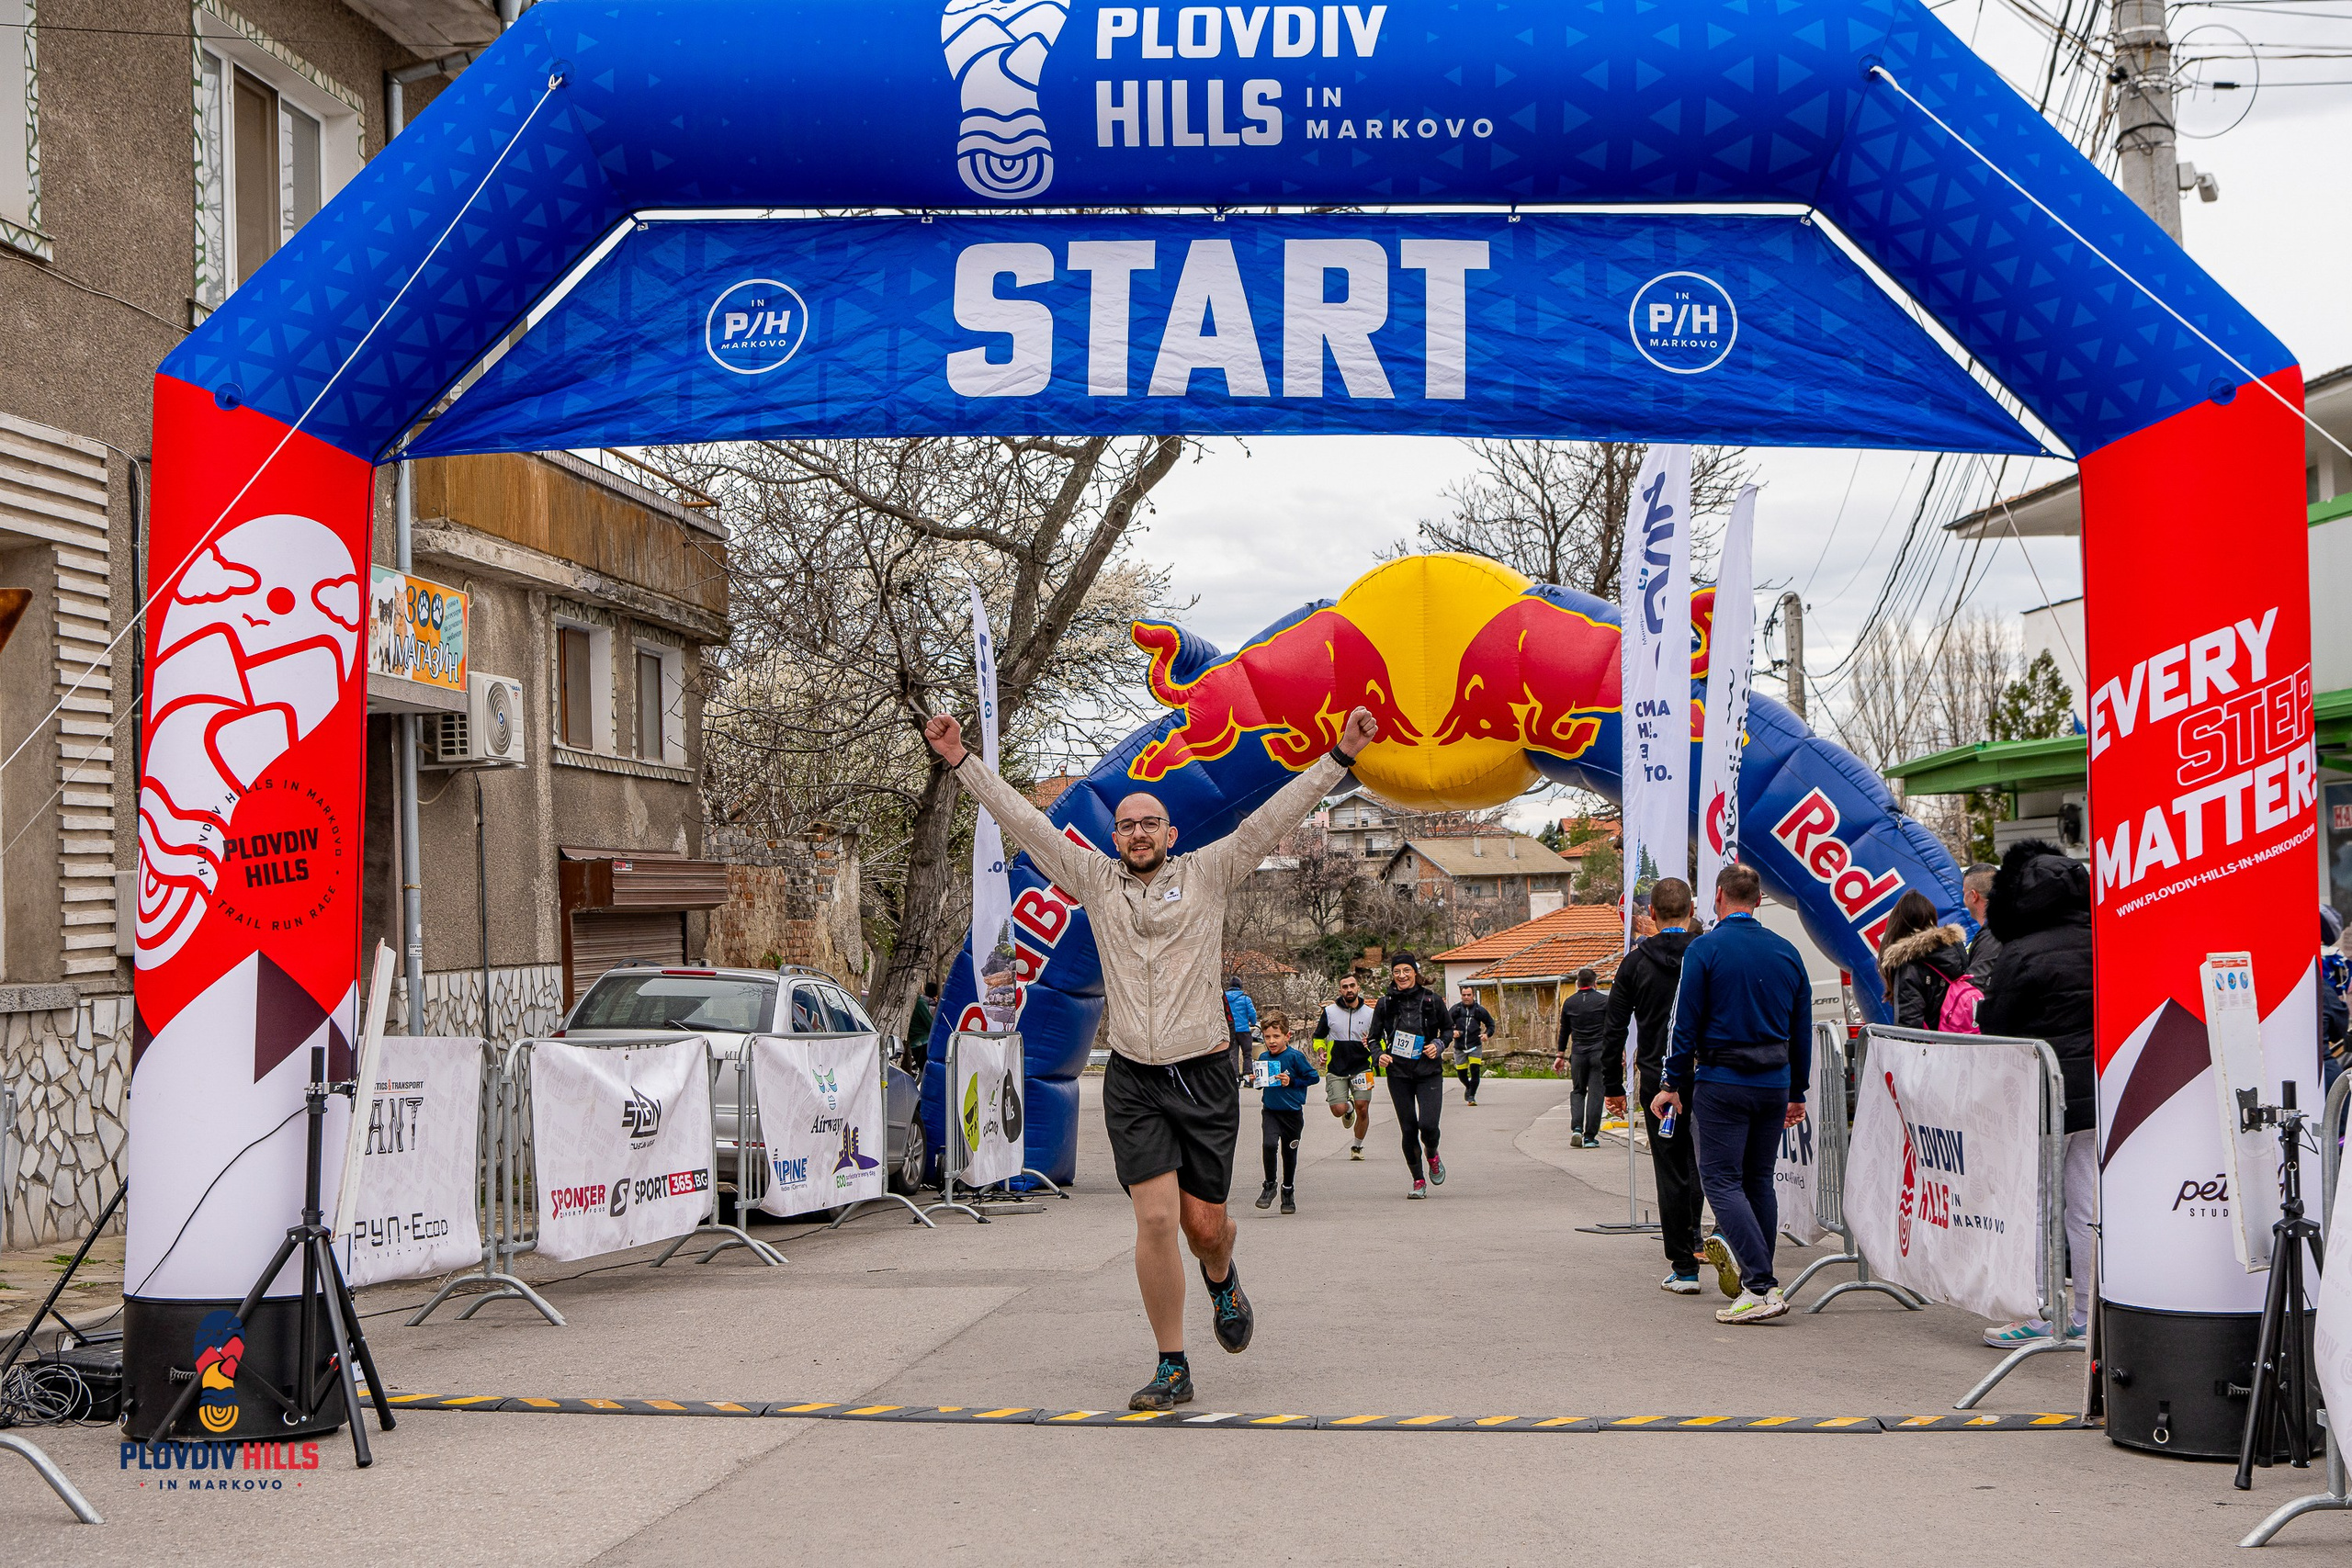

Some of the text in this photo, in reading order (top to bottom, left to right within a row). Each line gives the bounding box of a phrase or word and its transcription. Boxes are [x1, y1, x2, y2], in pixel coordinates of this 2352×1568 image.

[1096, 5, 1388, 60] PLOVDIV
[1096, 78, 1283, 147] HILLS
[1306, 86, 1342, 107] IN
[1306, 118, 1494, 140] MARKOVO
[751, 299, 764, 307] IN
[1675, 291, 1690, 300] IN
[724, 310, 791, 341] P/H
[945, 238, 1490, 400] START
[1648, 302, 1718, 337] P/H
[720, 339, 786, 350] MARKOVO
[1649, 337, 1718, 349] MARKOVO
[394, 633, 459, 682] МАГАЗИН
[2091, 606, 2278, 761] EVERY
[2177, 661, 2312, 786] STEP
[197, 778, 343, 876] PLOVDIV HILLS IN MARKOVO
[222, 827, 319, 863] PLOVDIV
[1773, 789, 1903, 920] Red
[244, 858, 310, 888] HILLS
[2116, 823, 2315, 918] WWW.PLOVDIV-HILLS-IN-MARKOVO.COM
[217, 885, 336, 931] TRAIL RUN RACE
[1397, 1038, 1409, 1048] 137
[551, 1185, 606, 1221] SPONSER
[1951, 1193, 1962, 1208] IN
[2189, 1208, 2229, 1218] STUD
[1952, 1213, 2005, 1235] MARKOVO
